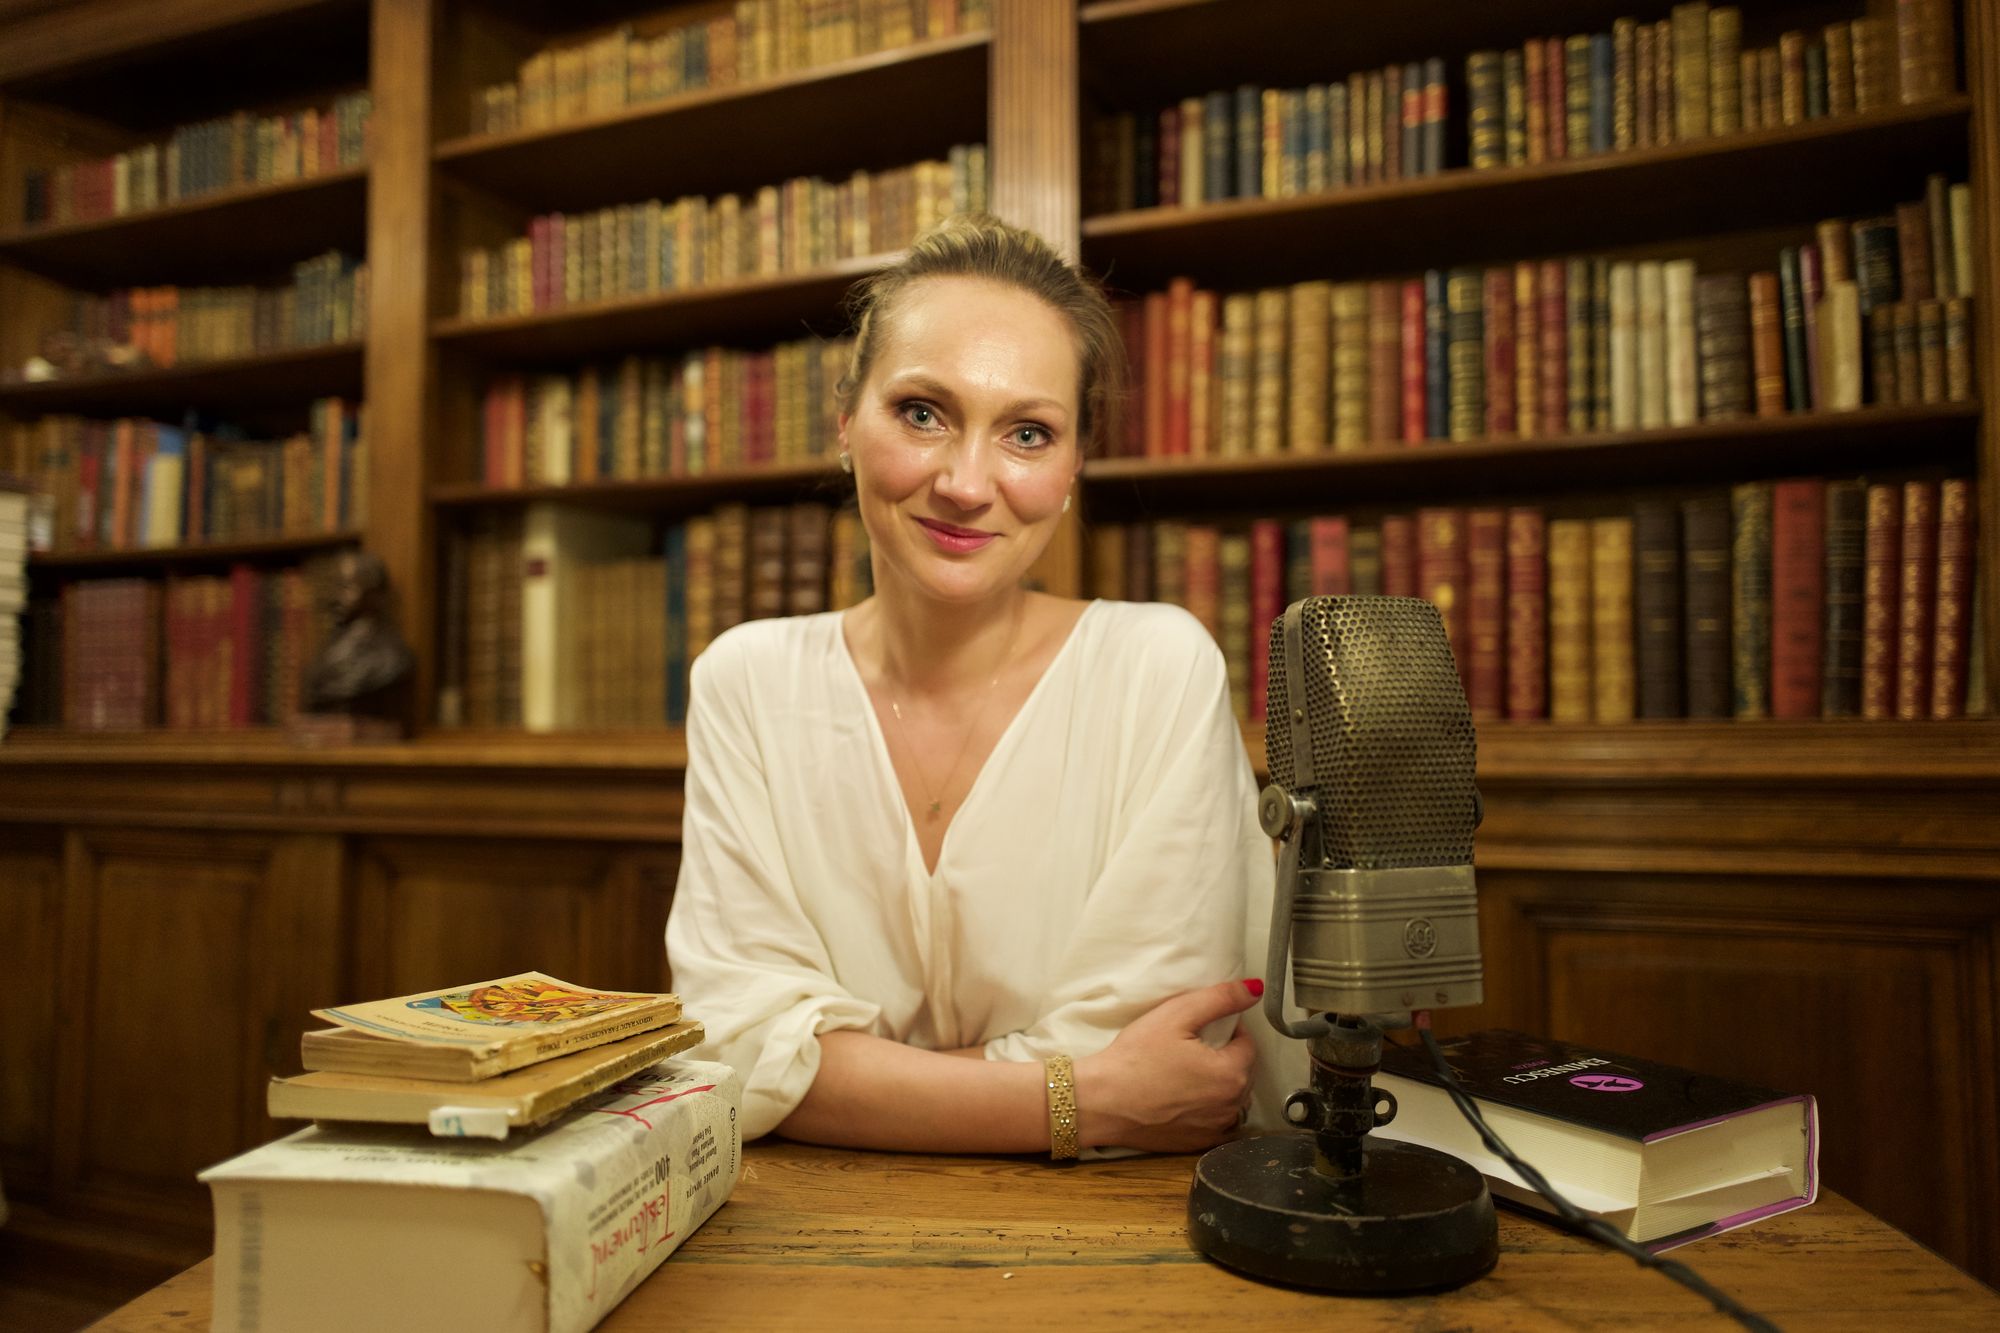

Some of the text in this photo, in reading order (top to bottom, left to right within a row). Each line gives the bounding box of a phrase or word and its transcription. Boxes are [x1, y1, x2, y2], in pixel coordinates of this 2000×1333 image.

[1503, 1058, 1611, 1084] EMINESCU
[655, 1154, 670, 1186] 400
[703, 1165, 719, 1185] DANIEL
[587, 1180, 675, 1301] Testament
